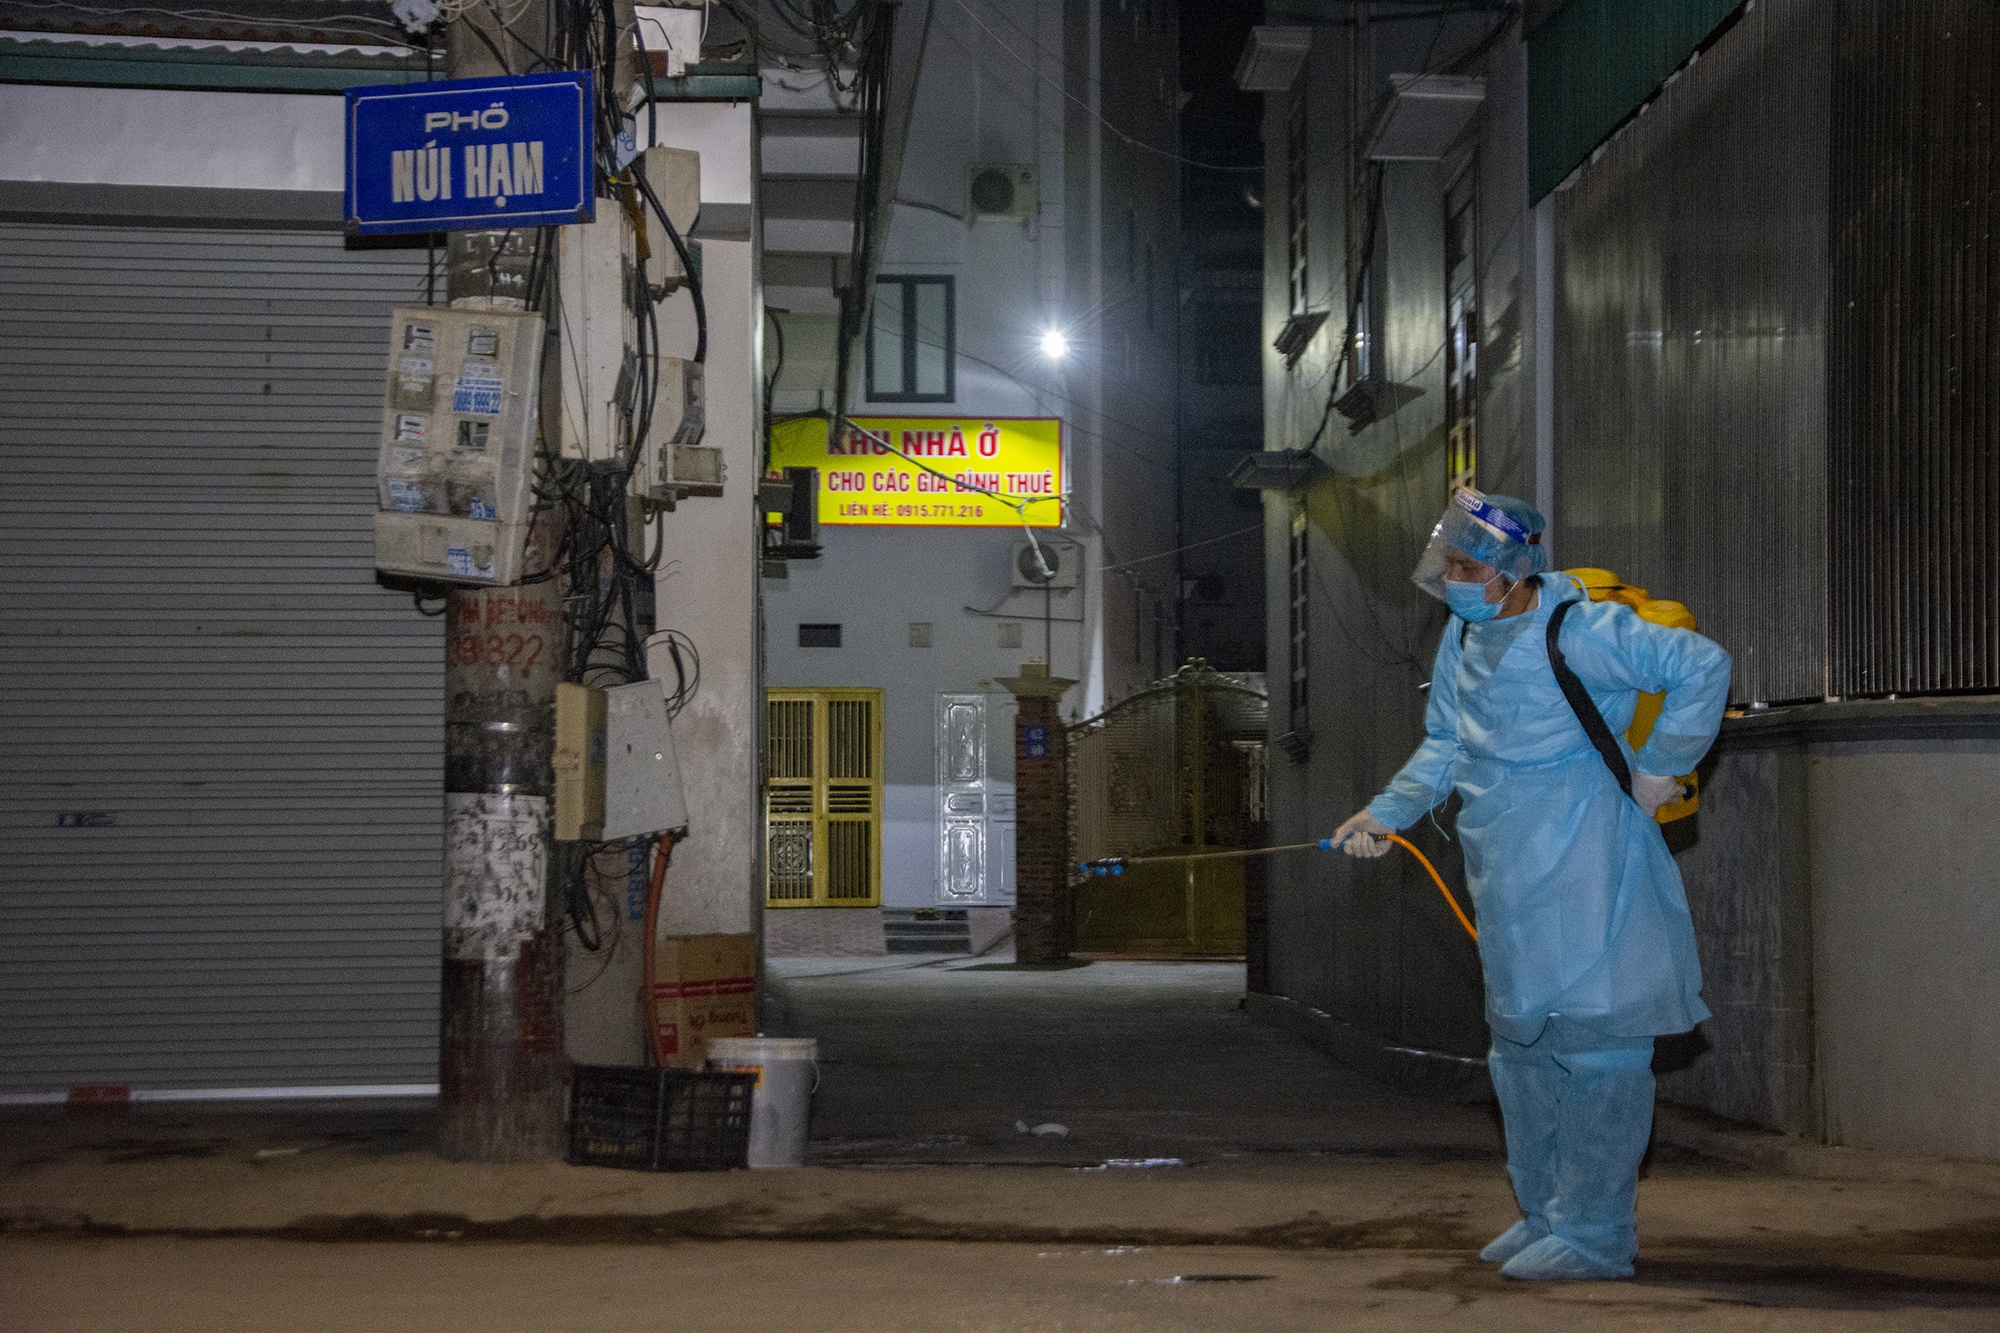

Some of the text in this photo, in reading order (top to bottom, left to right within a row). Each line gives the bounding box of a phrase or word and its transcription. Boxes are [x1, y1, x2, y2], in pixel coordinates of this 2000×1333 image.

[425, 102, 509, 133] PHỐ
[391, 139, 544, 207] NÚI HẠM
[902, 424, 967, 457] NHÀ
[978, 421, 1000, 457] Ở
[828, 470, 866, 492] CHO
[873, 467, 910, 493] CÁC
[917, 472, 948, 493] GIA
[1006, 469, 1053, 494] THUÊ
[840, 501, 868, 516] LIÊN
[897, 503, 984, 518] 0915.771.216
